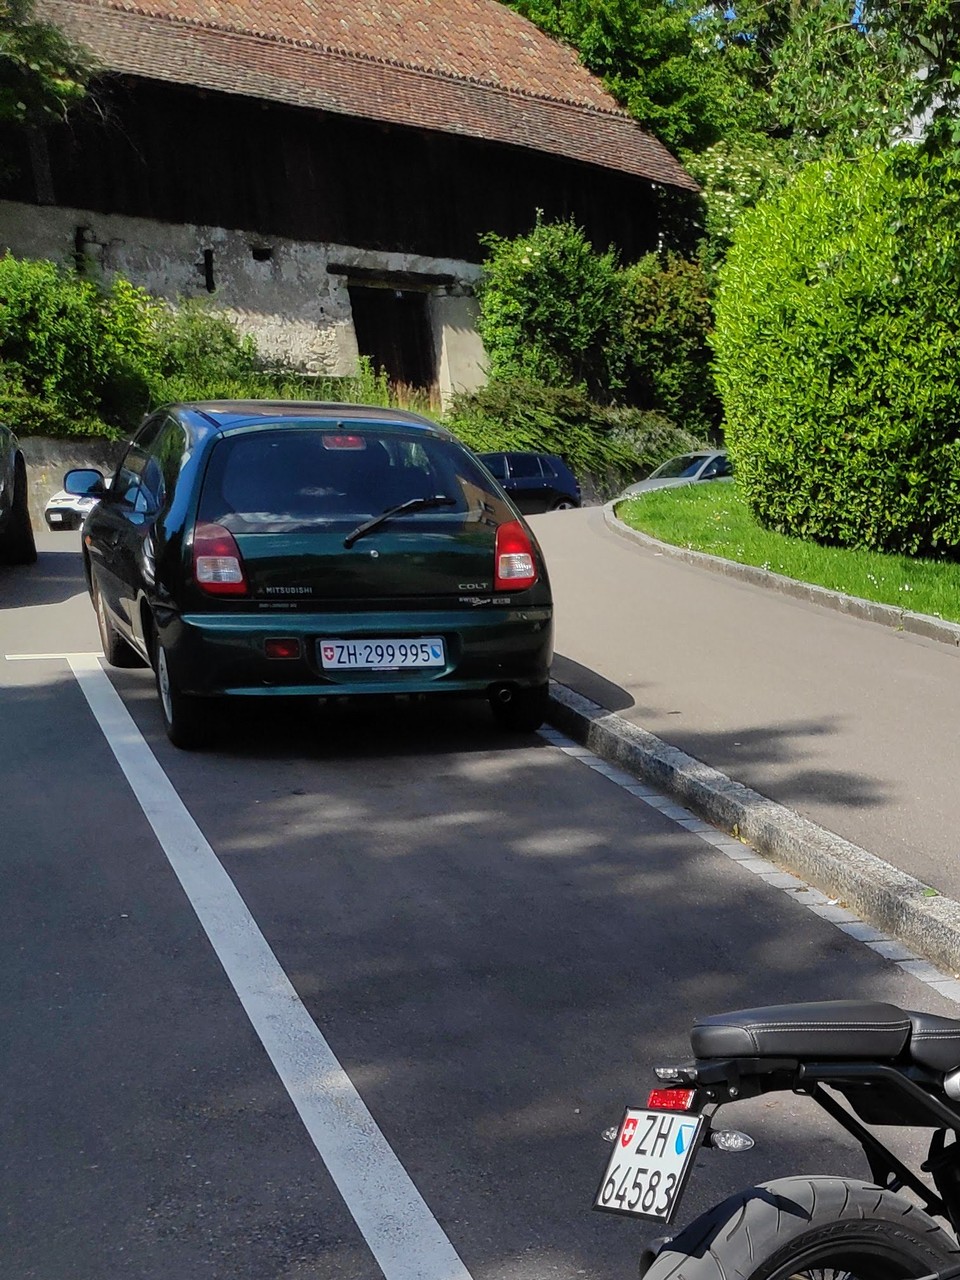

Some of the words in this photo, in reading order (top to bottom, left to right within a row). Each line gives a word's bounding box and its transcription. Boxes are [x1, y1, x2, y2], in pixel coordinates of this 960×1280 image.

[266, 586, 313, 594] MITSUBISHI
[458, 582, 488, 590] COLT
[635, 1115, 674, 1157] ZH
[602, 1164, 677, 1214] 64583
